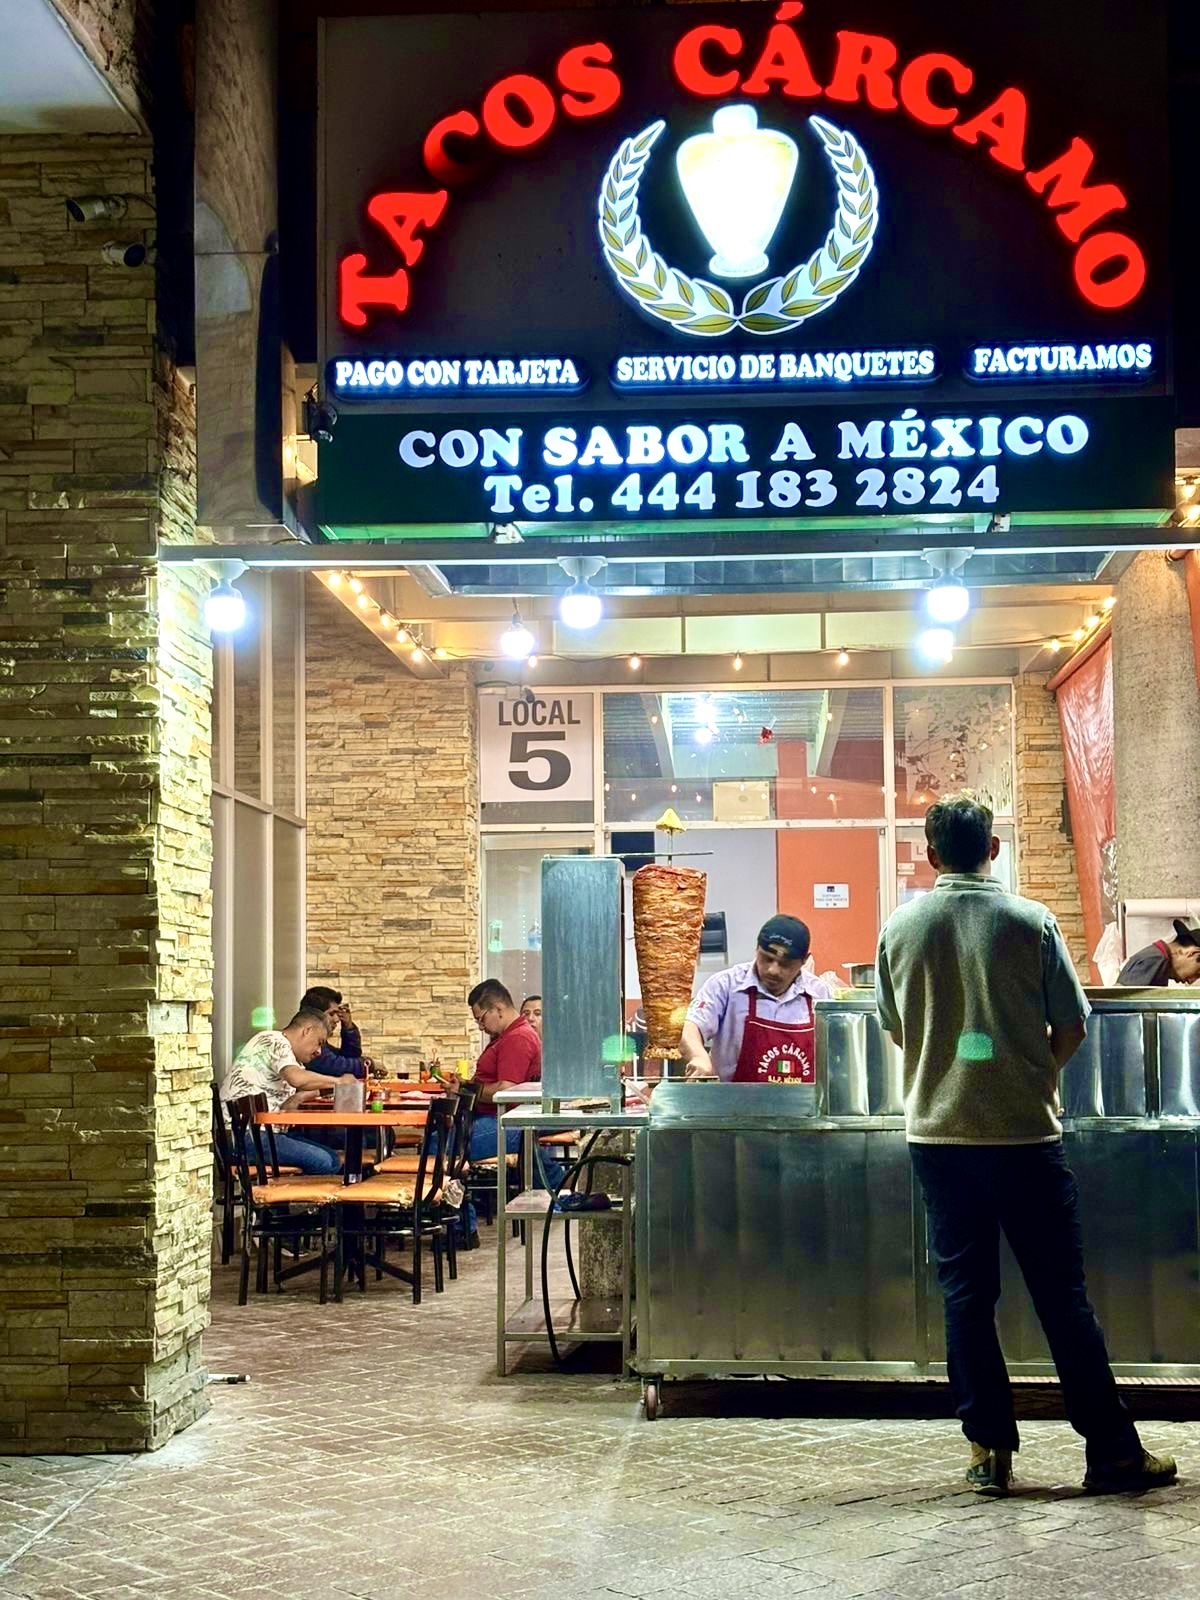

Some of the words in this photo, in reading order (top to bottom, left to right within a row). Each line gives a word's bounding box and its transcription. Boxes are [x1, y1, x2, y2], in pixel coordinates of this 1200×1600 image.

[341, 42, 621, 326] TACOS
[674, 1, 1146, 308] CÁRCAMO
[335, 359, 404, 387] PAGO
[407, 359, 461, 386] CON
[464, 358, 580, 385] TARJETA
[617, 354, 736, 381] SERVICIO
[740, 353, 776, 380] DE
[779, 350, 935, 382] BANQUETES
[974, 343, 1152, 374] FACTURAMOS
[399, 428, 523, 469] CON
[543, 424, 750, 467] SABOR
[770, 422, 817, 462] A
[837, 408, 1089, 460] MÉXICO
[484, 474, 594, 514] Tel.
[611, 471, 716, 512] 444
[735, 469, 838, 509] 183
[856, 464, 1000, 508] 2824
[498, 700, 581, 726] LOCAL
[508, 731, 571, 791] 5
[757, 1046, 780, 1074] TACOS
[781, 1042, 811, 1076] CÁRCAMO
